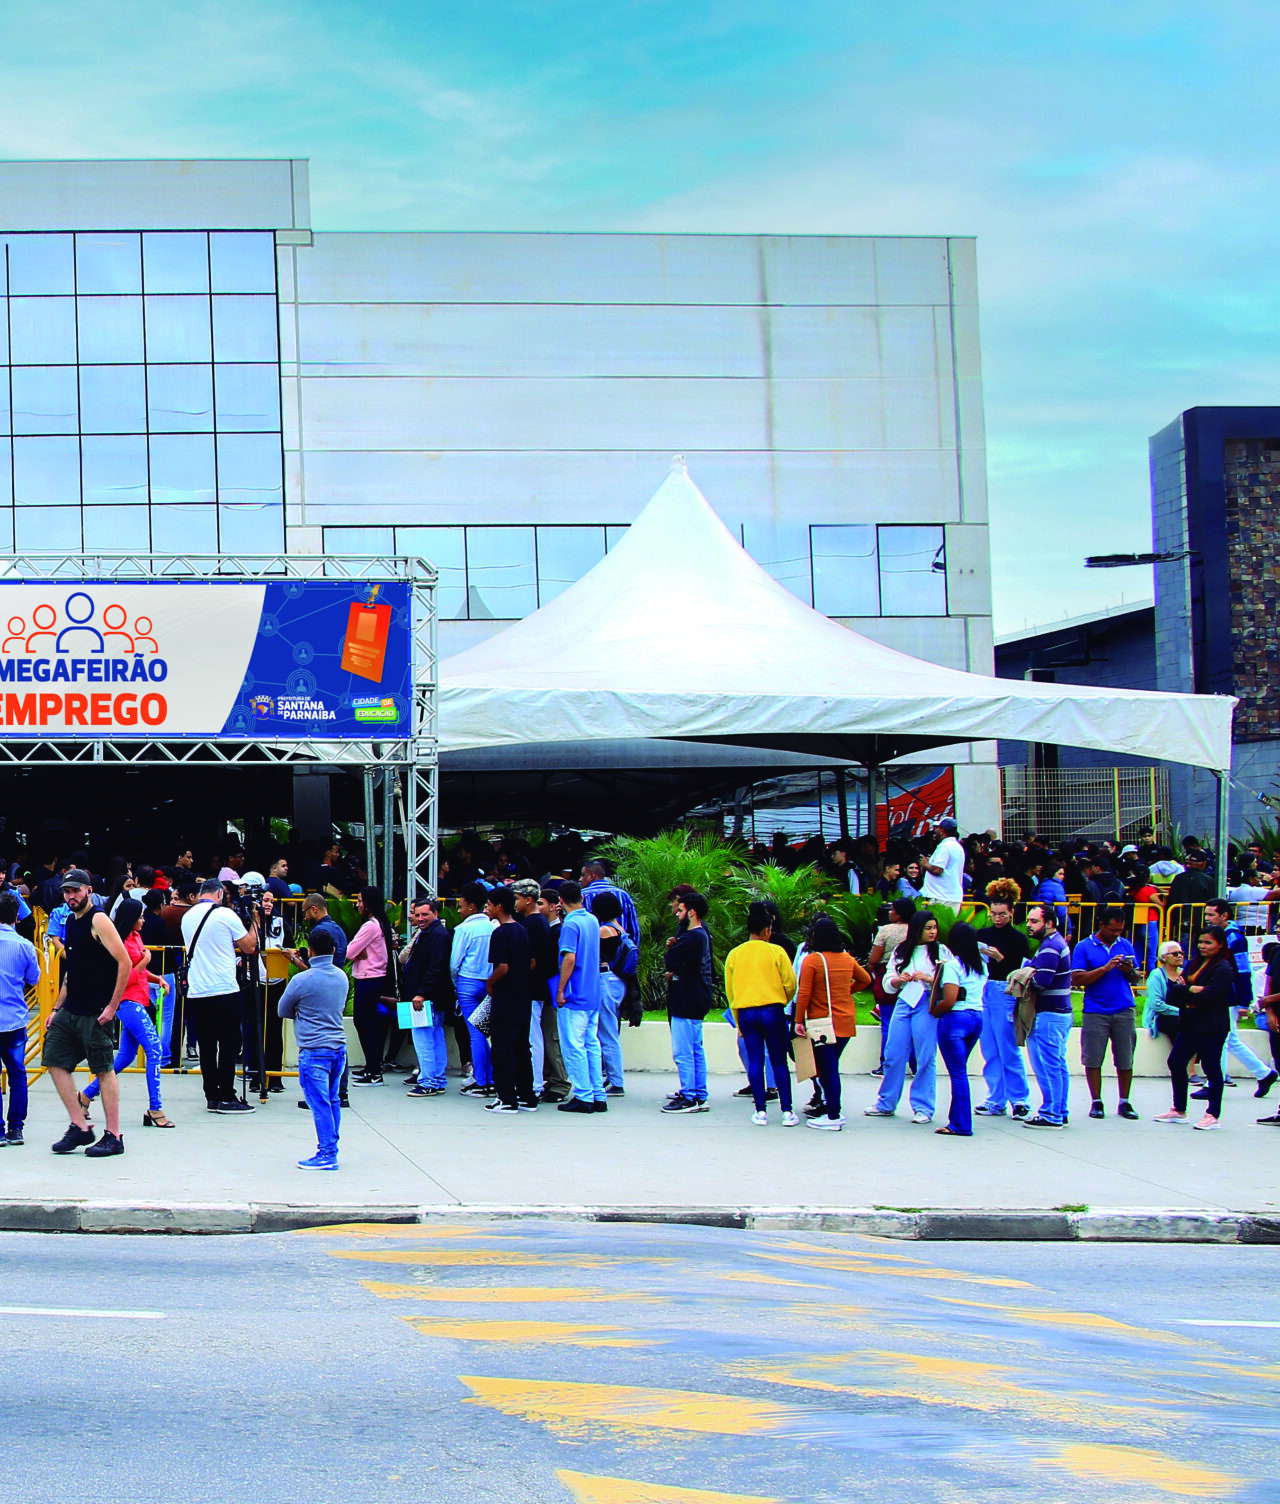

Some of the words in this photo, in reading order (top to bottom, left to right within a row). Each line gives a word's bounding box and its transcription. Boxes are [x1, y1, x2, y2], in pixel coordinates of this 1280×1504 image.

[278, 701, 324, 710] SANTANA
[353, 697, 379, 705] CIDADE
[284, 709, 336, 719] PARNAÍBA
[358, 709, 393, 718] EDUCAÇÃO
